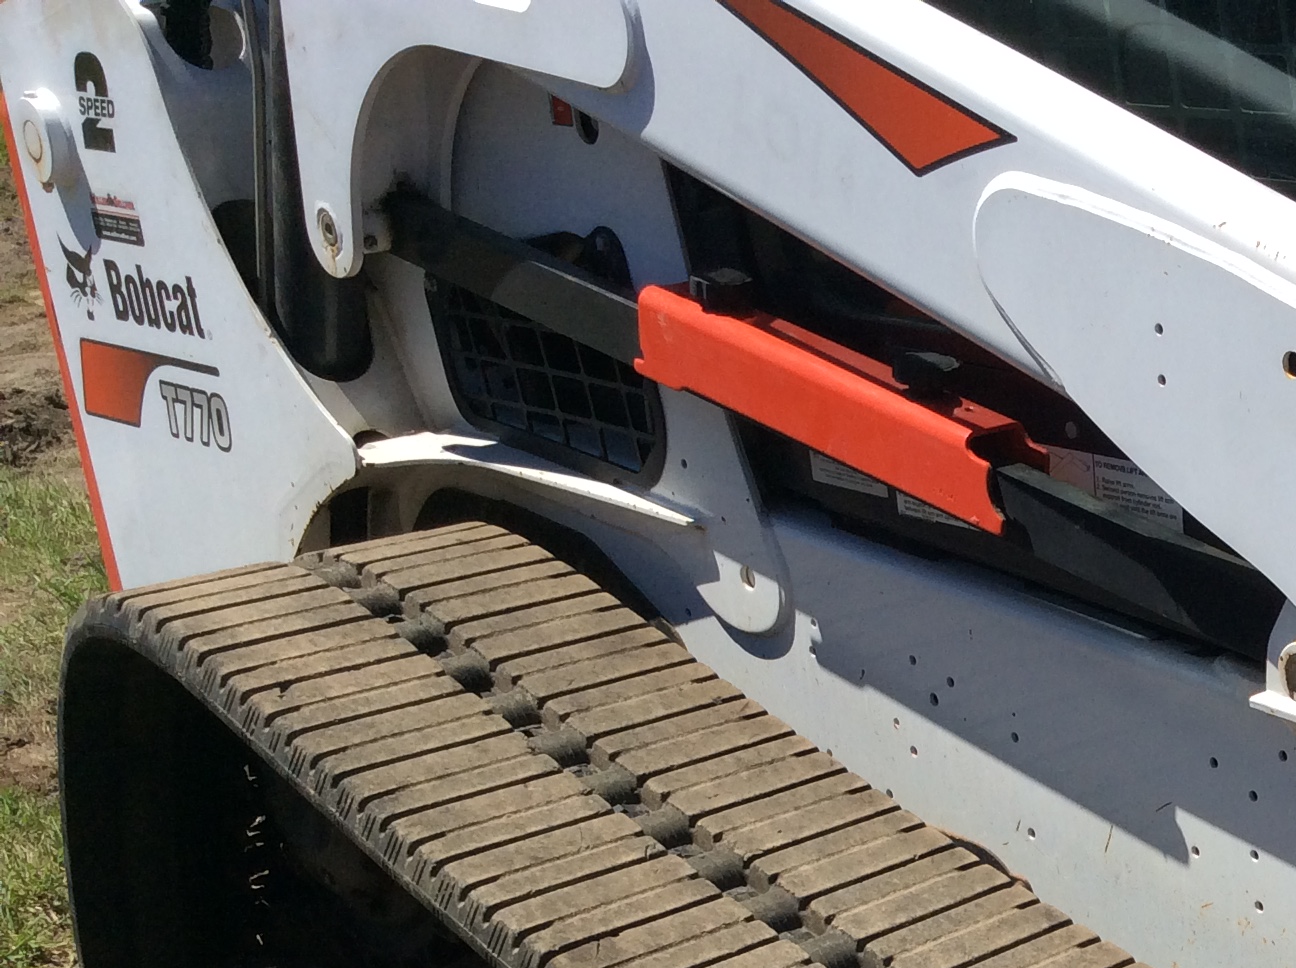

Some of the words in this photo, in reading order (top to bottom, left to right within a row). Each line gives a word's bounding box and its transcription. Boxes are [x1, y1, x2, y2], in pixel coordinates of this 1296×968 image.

[74, 51, 116, 153] 2
[78, 96, 115, 118] SPEED
[103, 258, 206, 340] Bobcat
[159, 379, 233, 453] T770
[1103, 463, 1126, 474] REMOVE
[1126, 467, 1138, 476] LIFT
